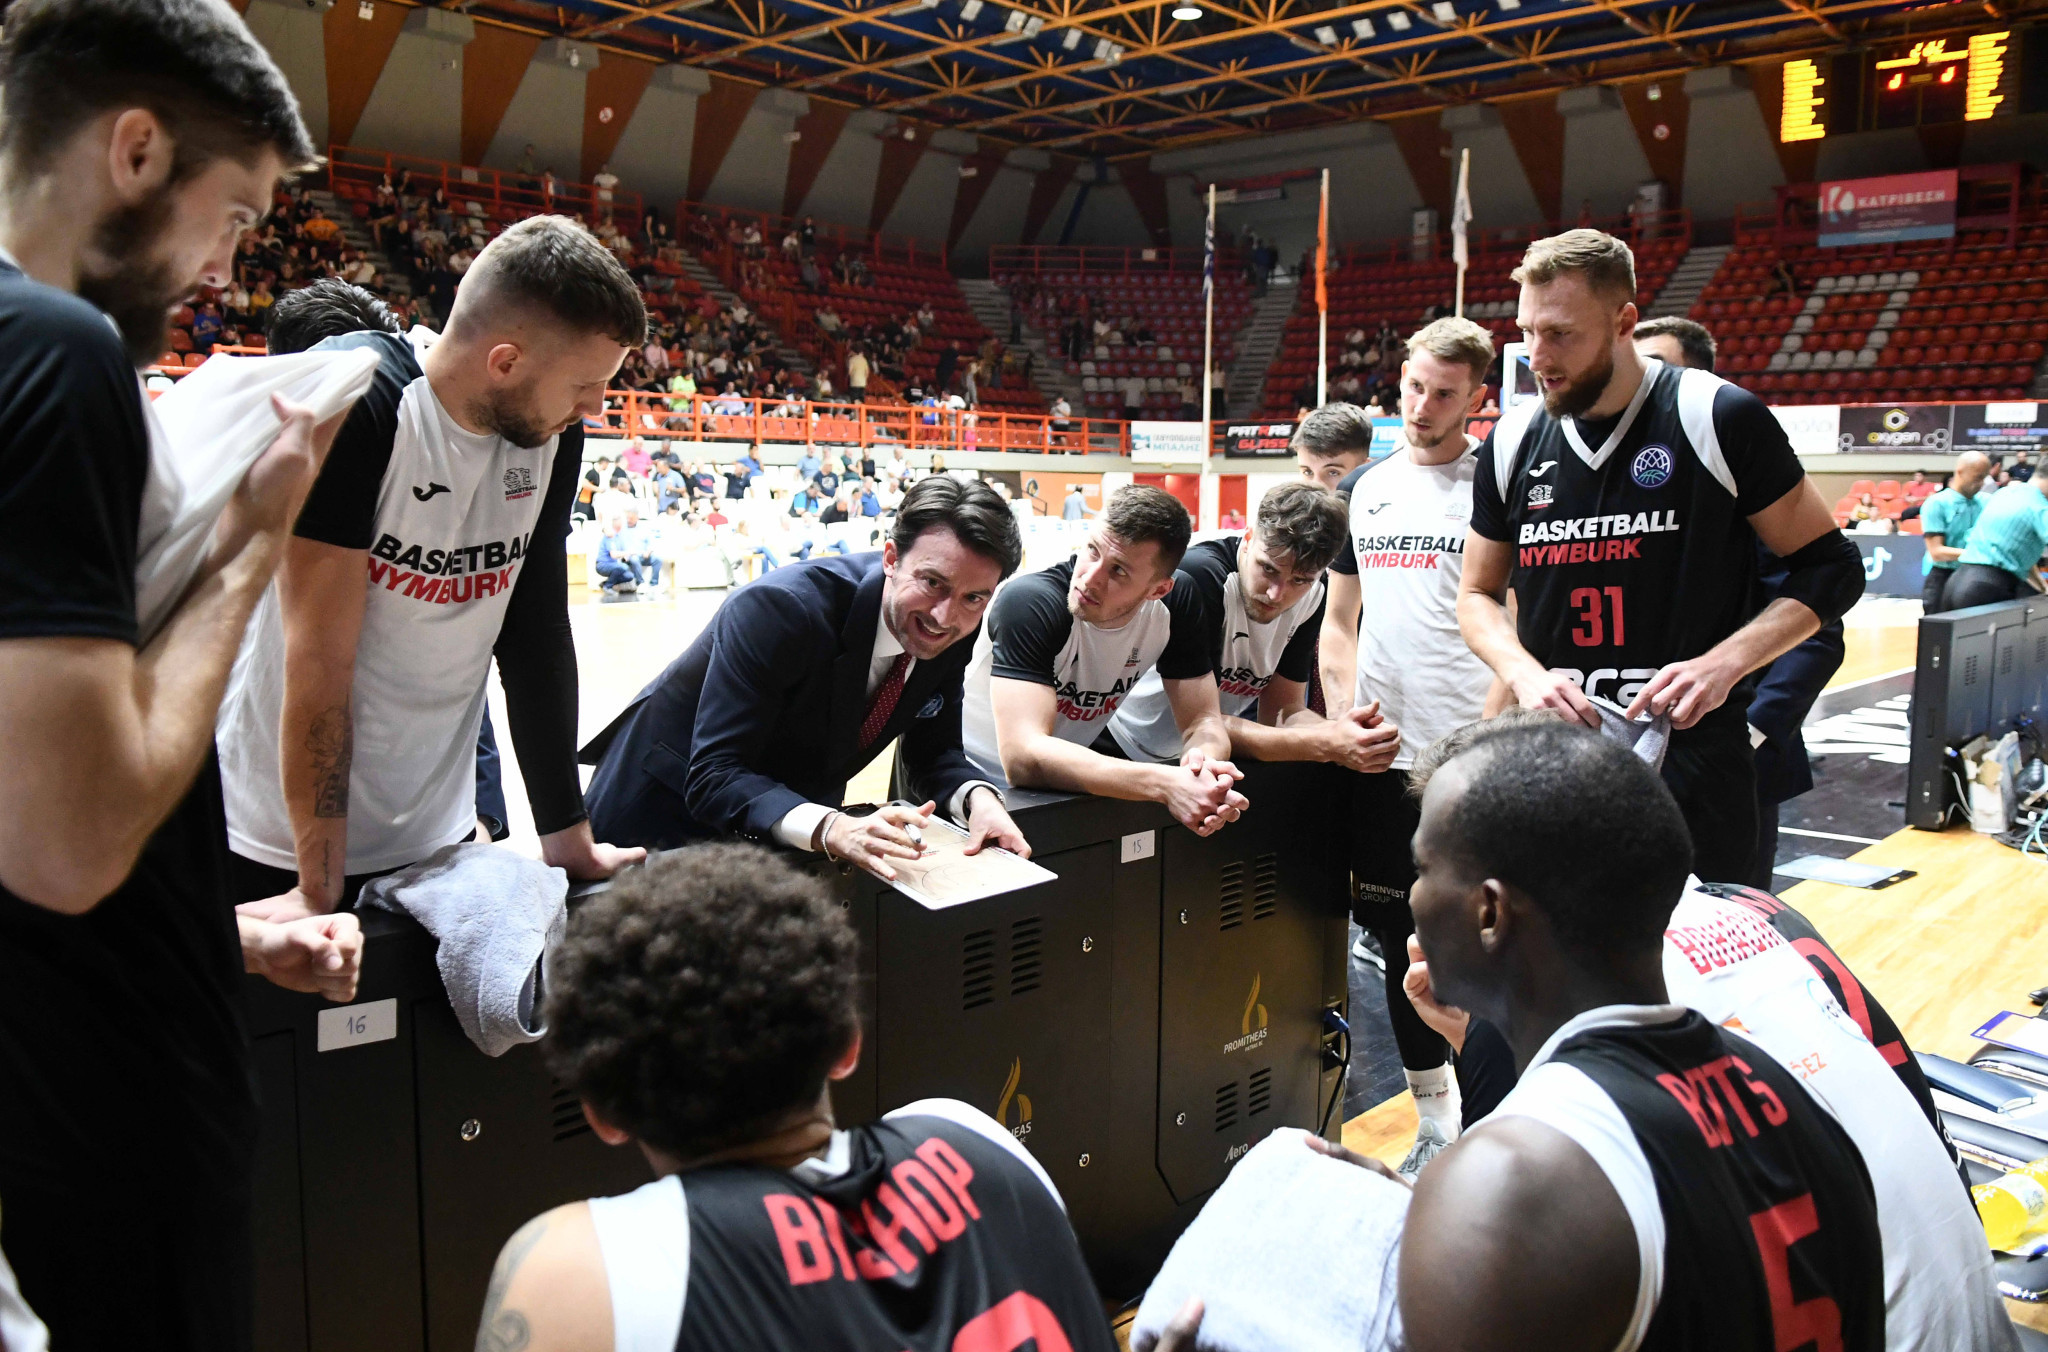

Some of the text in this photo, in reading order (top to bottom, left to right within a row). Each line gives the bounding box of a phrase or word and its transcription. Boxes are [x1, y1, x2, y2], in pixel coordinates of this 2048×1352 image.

[1238, 438, 1289, 449] GLASS
[1519, 509, 1680, 545] BASKETBALL
[371, 533, 530, 577] BASKETBAL
[1360, 552, 1440, 570] NYMBURK
[1519, 537, 1643, 567] NYMBURK
[368, 556, 515, 604] NYMBURK
[1570, 586, 1625, 647] 31
[1133, 838, 1142, 854] 15
[1360, 882, 1405, 899] PERINVEST
[1360, 891, 1391, 903] GROUP
[345, 1014, 367, 1035] 16
[1223, 1028, 1268, 1054] PROMITHEAS
[1224, 1143, 1249, 1164] Aero
[1750, 1193, 1844, 1352] 5
